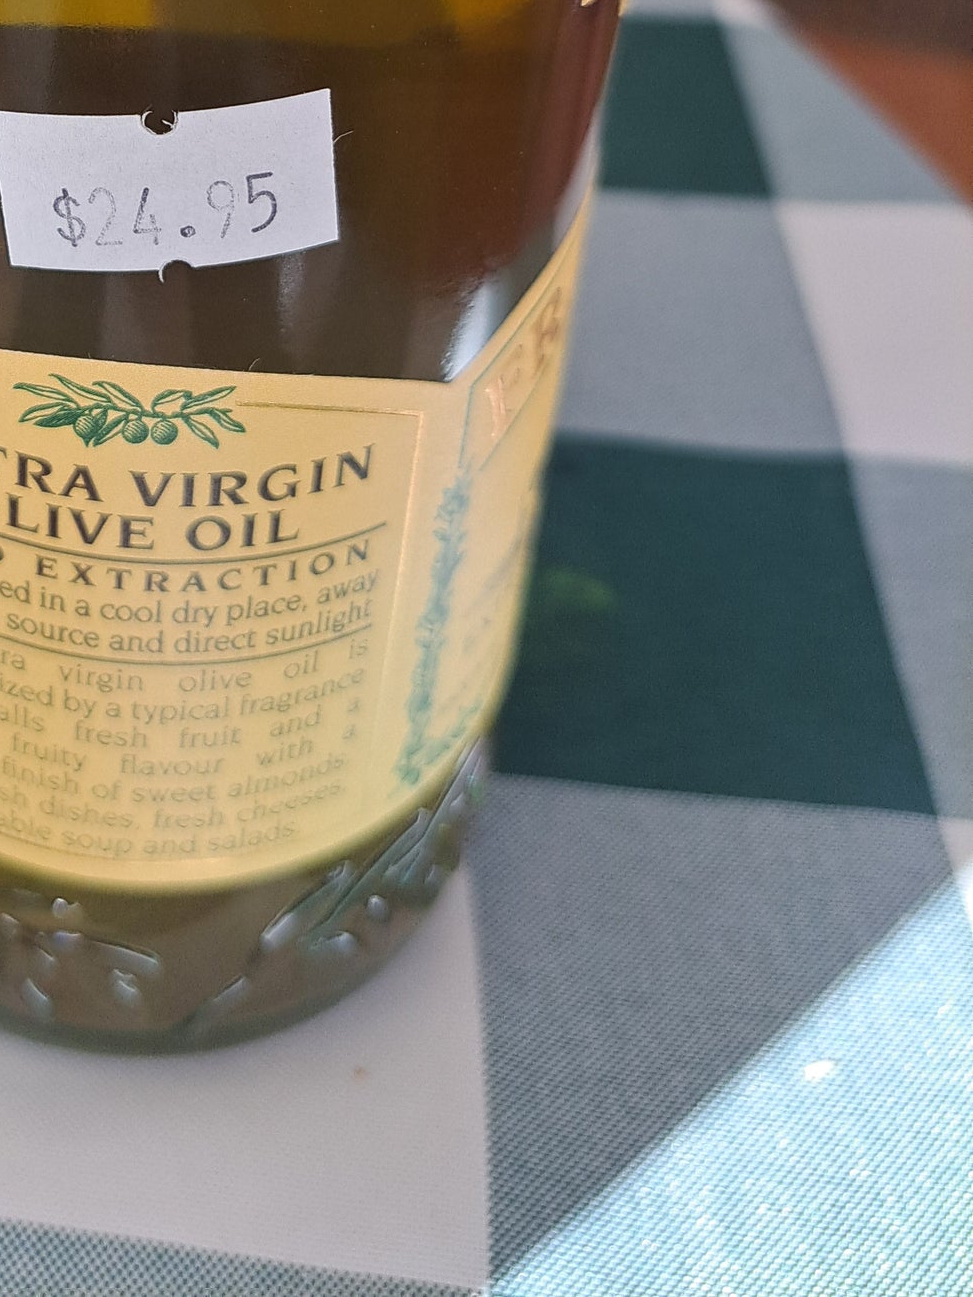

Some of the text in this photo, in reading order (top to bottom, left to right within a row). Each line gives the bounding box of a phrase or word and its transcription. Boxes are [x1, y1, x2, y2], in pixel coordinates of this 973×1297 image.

[52, 172, 278, 248] $24.95
[128, 443, 375, 508] VIRGIN
[185, 508, 300, 551] OIL
[35, 539, 370, 593] EXTRACTION
[40, 586, 66, 613] in
[74, 598, 91, 617] a
[100, 599, 162, 623] cool
[172, 601, 218, 628] dry
[227, 593, 307, 626] place,
[316, 567, 379, 603] away
[6, 611, 99, 647] source
[109, 631, 164, 653] and
[174, 630, 257, 653] direct
[265, 598, 372, 646] sunlight
[59, 664, 144, 694] virgin
[178, 669, 253, 693] olive
[283, 650, 320, 680] oil
[347, 638, 369, 660] is
[63, 689, 97, 719] by
[105, 700, 122, 718] a
[131, 698, 230, 725] typical
[239, 667, 365, 717] fragrance
[12, 730, 85, 772] fruity
[120, 753, 225, 776] flavour
[256, 736, 314, 768] with
[75, 719, 148, 749] fresh
[179, 726, 241, 749] fruit
[269, 703, 322, 738] and
[2, 755, 79, 792] finish
[91, 778, 122, 801] of
[132, 783, 217, 803] sweet
[227, 750, 346, 799] almonds
[61, 830, 132, 855] soup
[143, 836, 197, 855] and
